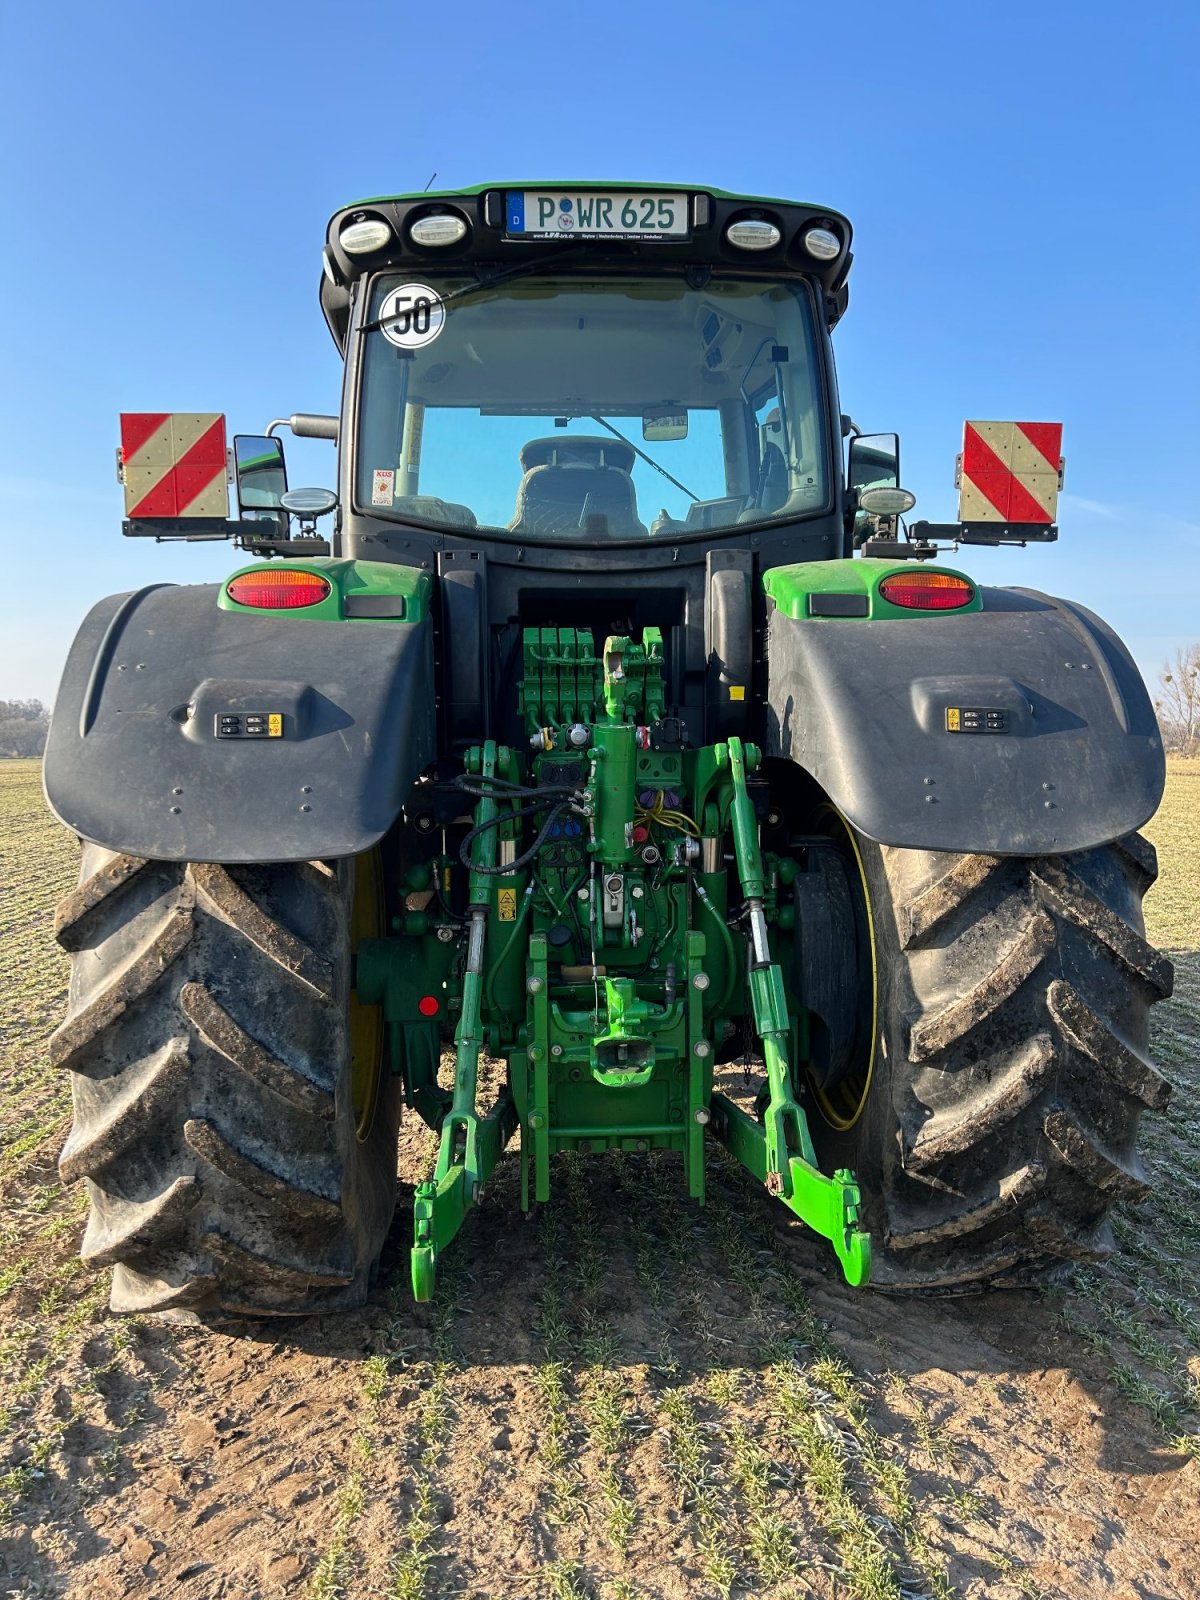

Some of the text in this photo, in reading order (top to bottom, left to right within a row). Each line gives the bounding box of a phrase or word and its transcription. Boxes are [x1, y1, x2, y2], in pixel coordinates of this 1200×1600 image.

[513, 215, 520, 225] D
[537, 197, 675, 229] P WR 625
[394, 295, 431, 335] 50
